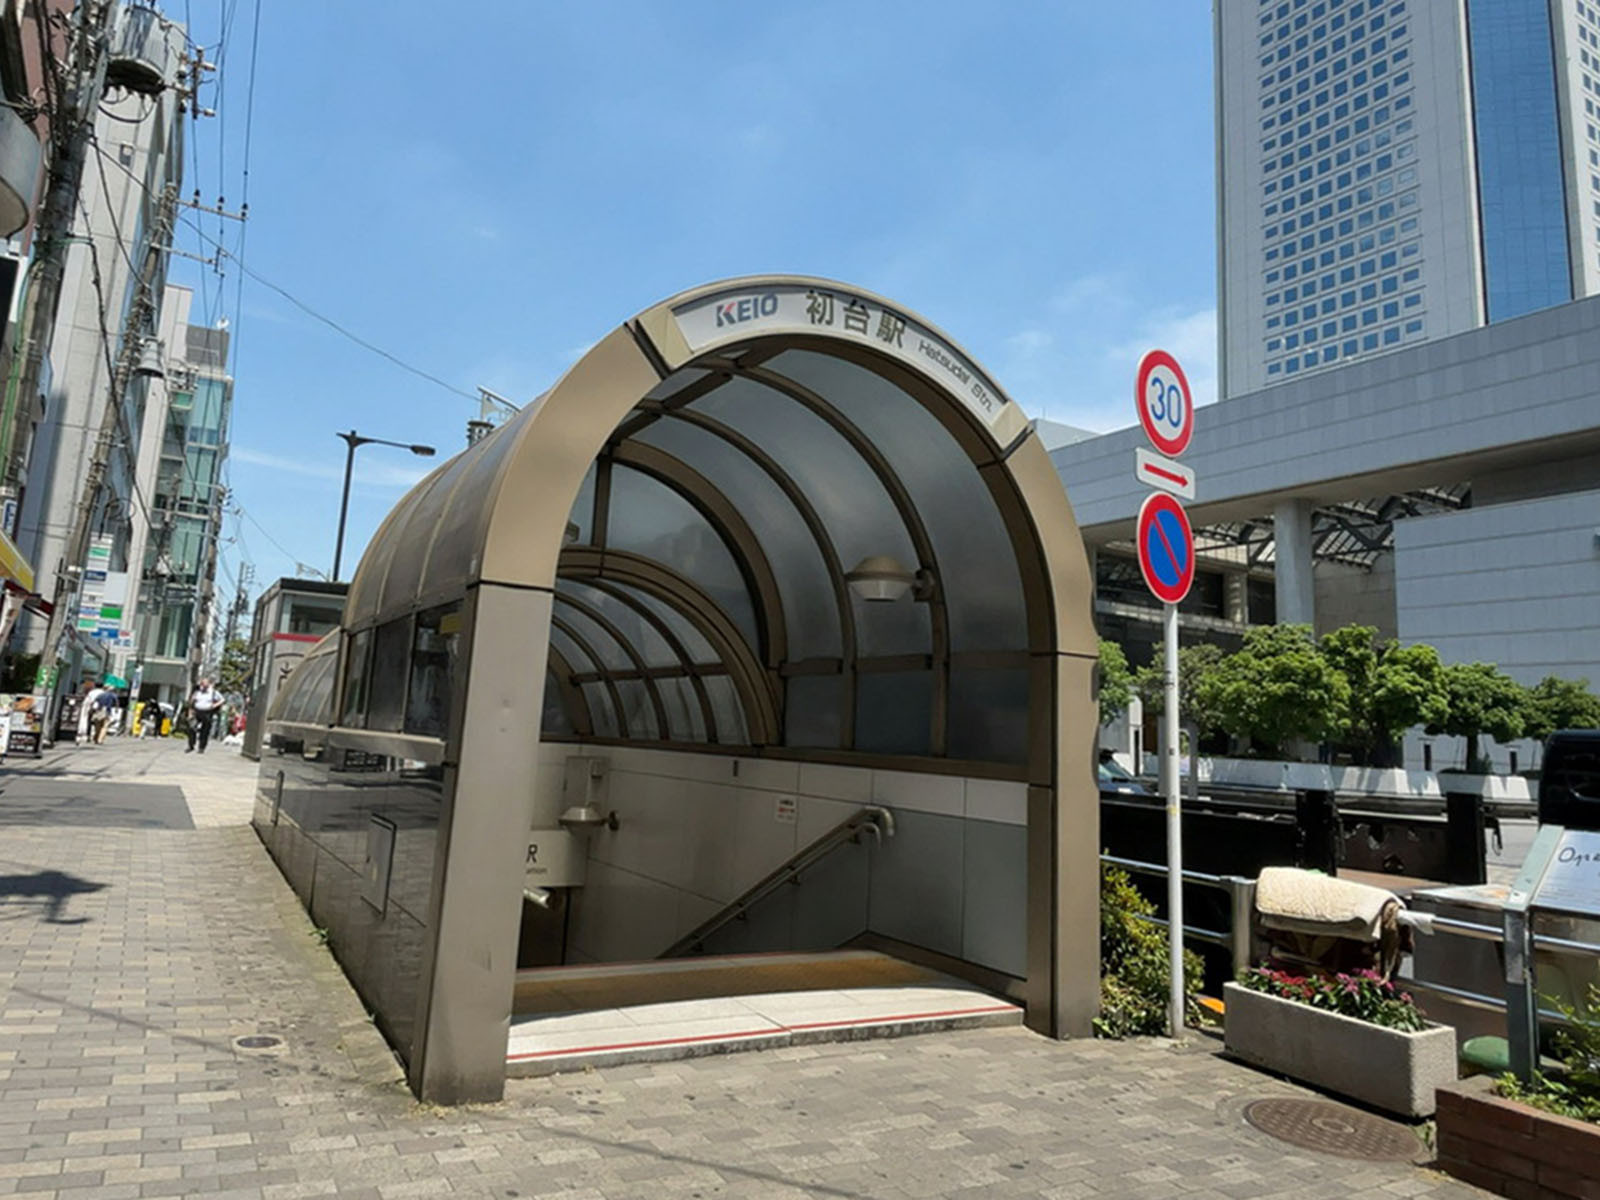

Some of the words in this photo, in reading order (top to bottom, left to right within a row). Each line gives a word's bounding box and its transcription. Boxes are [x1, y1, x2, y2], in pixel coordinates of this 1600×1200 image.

[716, 293, 778, 327] KEIO
[805, 289, 907, 349] 初台駅
[918, 340, 970, 385] Hatsudai
[1151, 377, 1181, 428] 30
